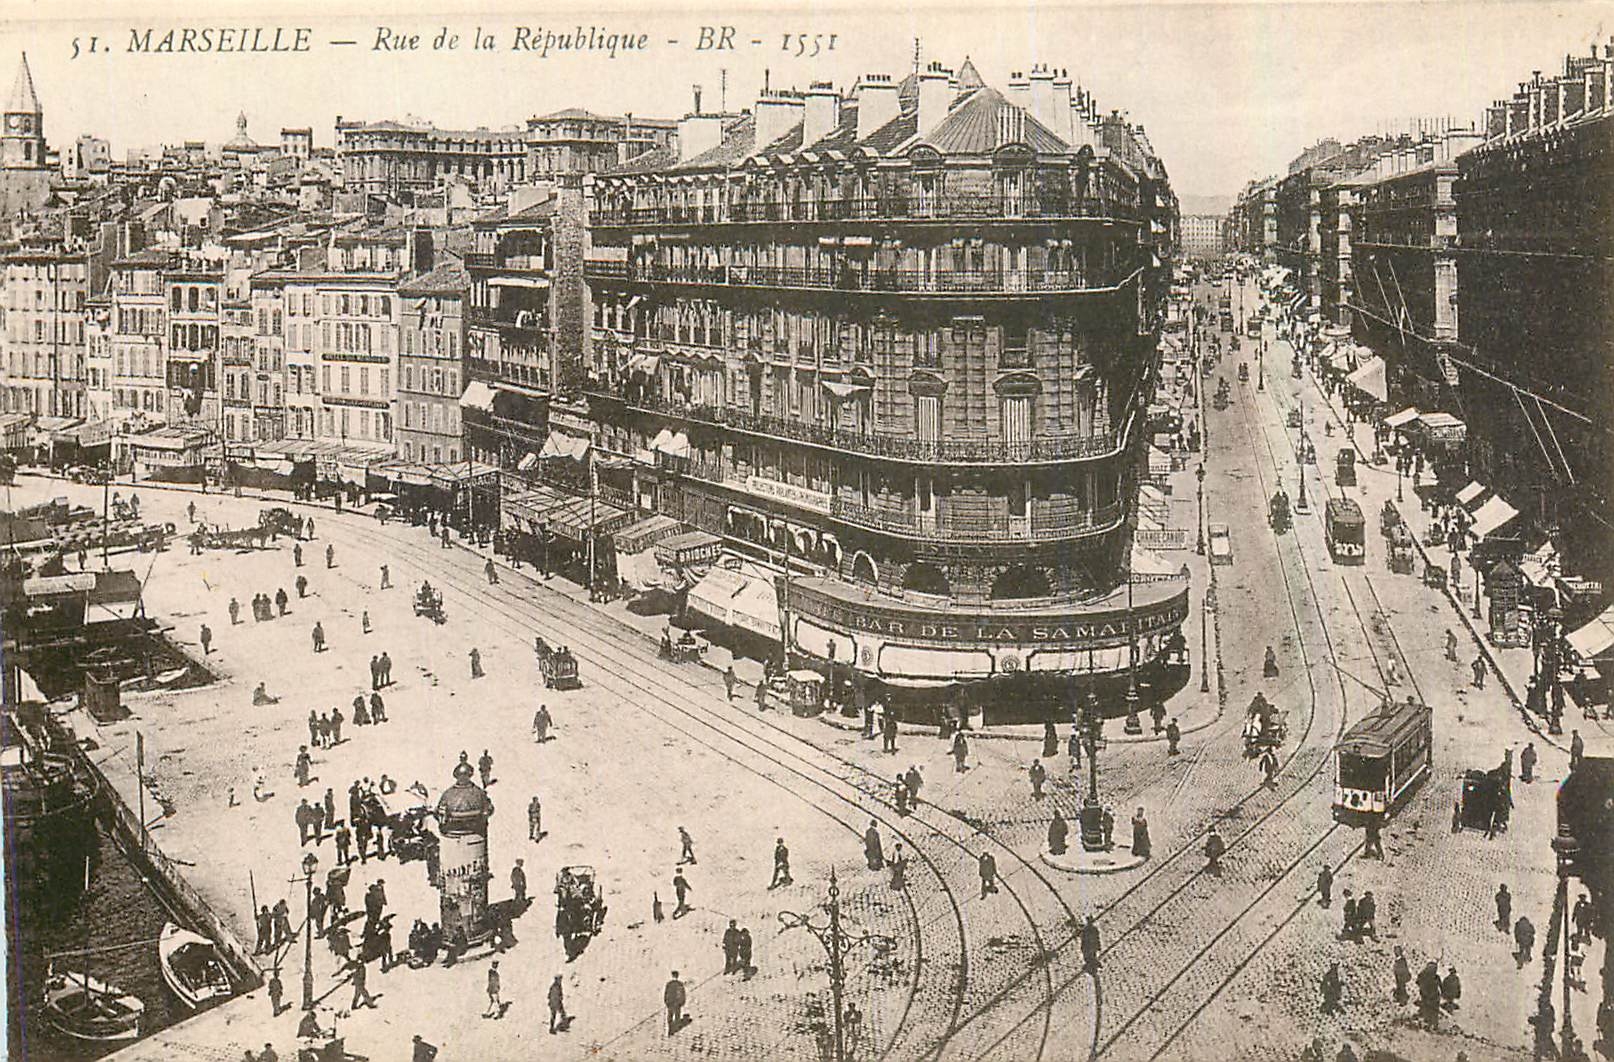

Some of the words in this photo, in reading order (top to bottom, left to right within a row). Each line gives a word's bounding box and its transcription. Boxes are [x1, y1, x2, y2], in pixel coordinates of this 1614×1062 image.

[855, 615, 904, 634] BAR
[920, 623, 959, 639] DE
[975, 626, 1018, 640] LA
